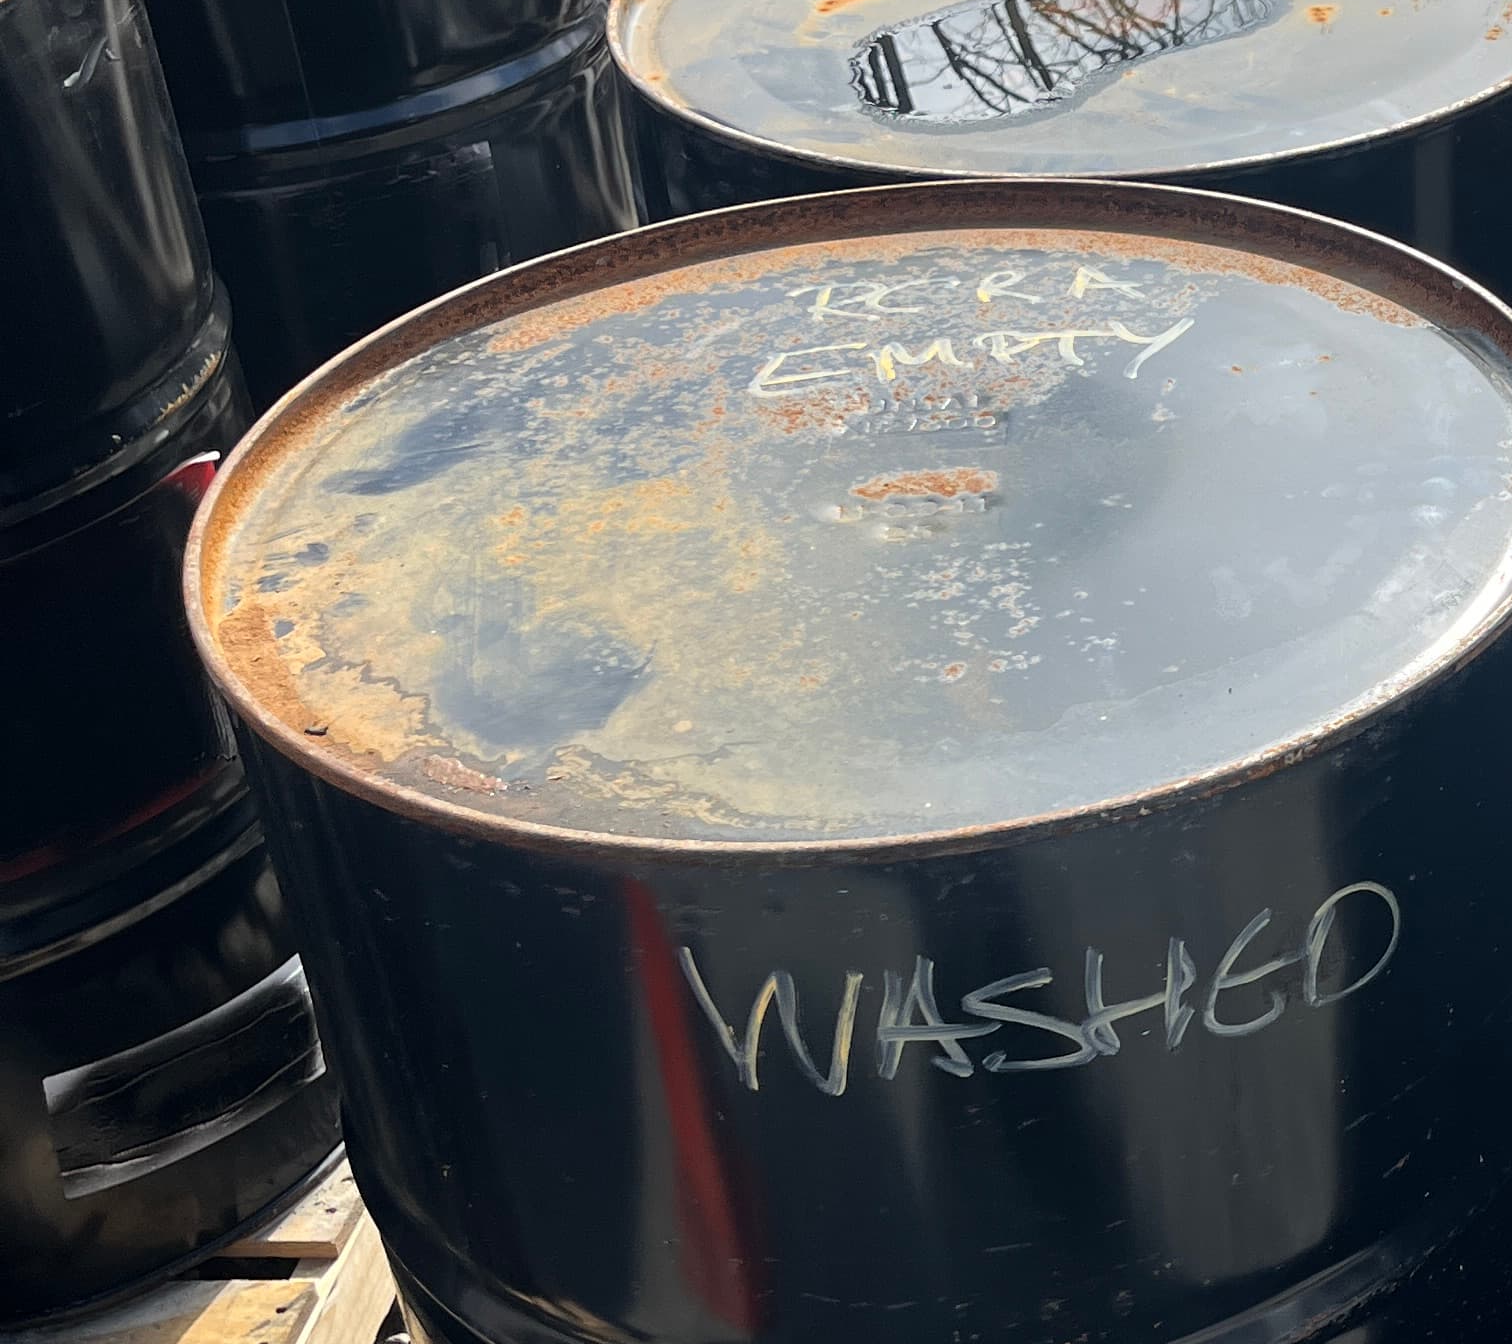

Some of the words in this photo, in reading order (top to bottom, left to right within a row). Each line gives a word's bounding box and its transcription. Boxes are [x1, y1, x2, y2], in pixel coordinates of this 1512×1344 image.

[785, 264, 1147, 322] RCRA
[748, 317, 1196, 397] EMPTY
[678, 880, 1401, 1097] WASHED
